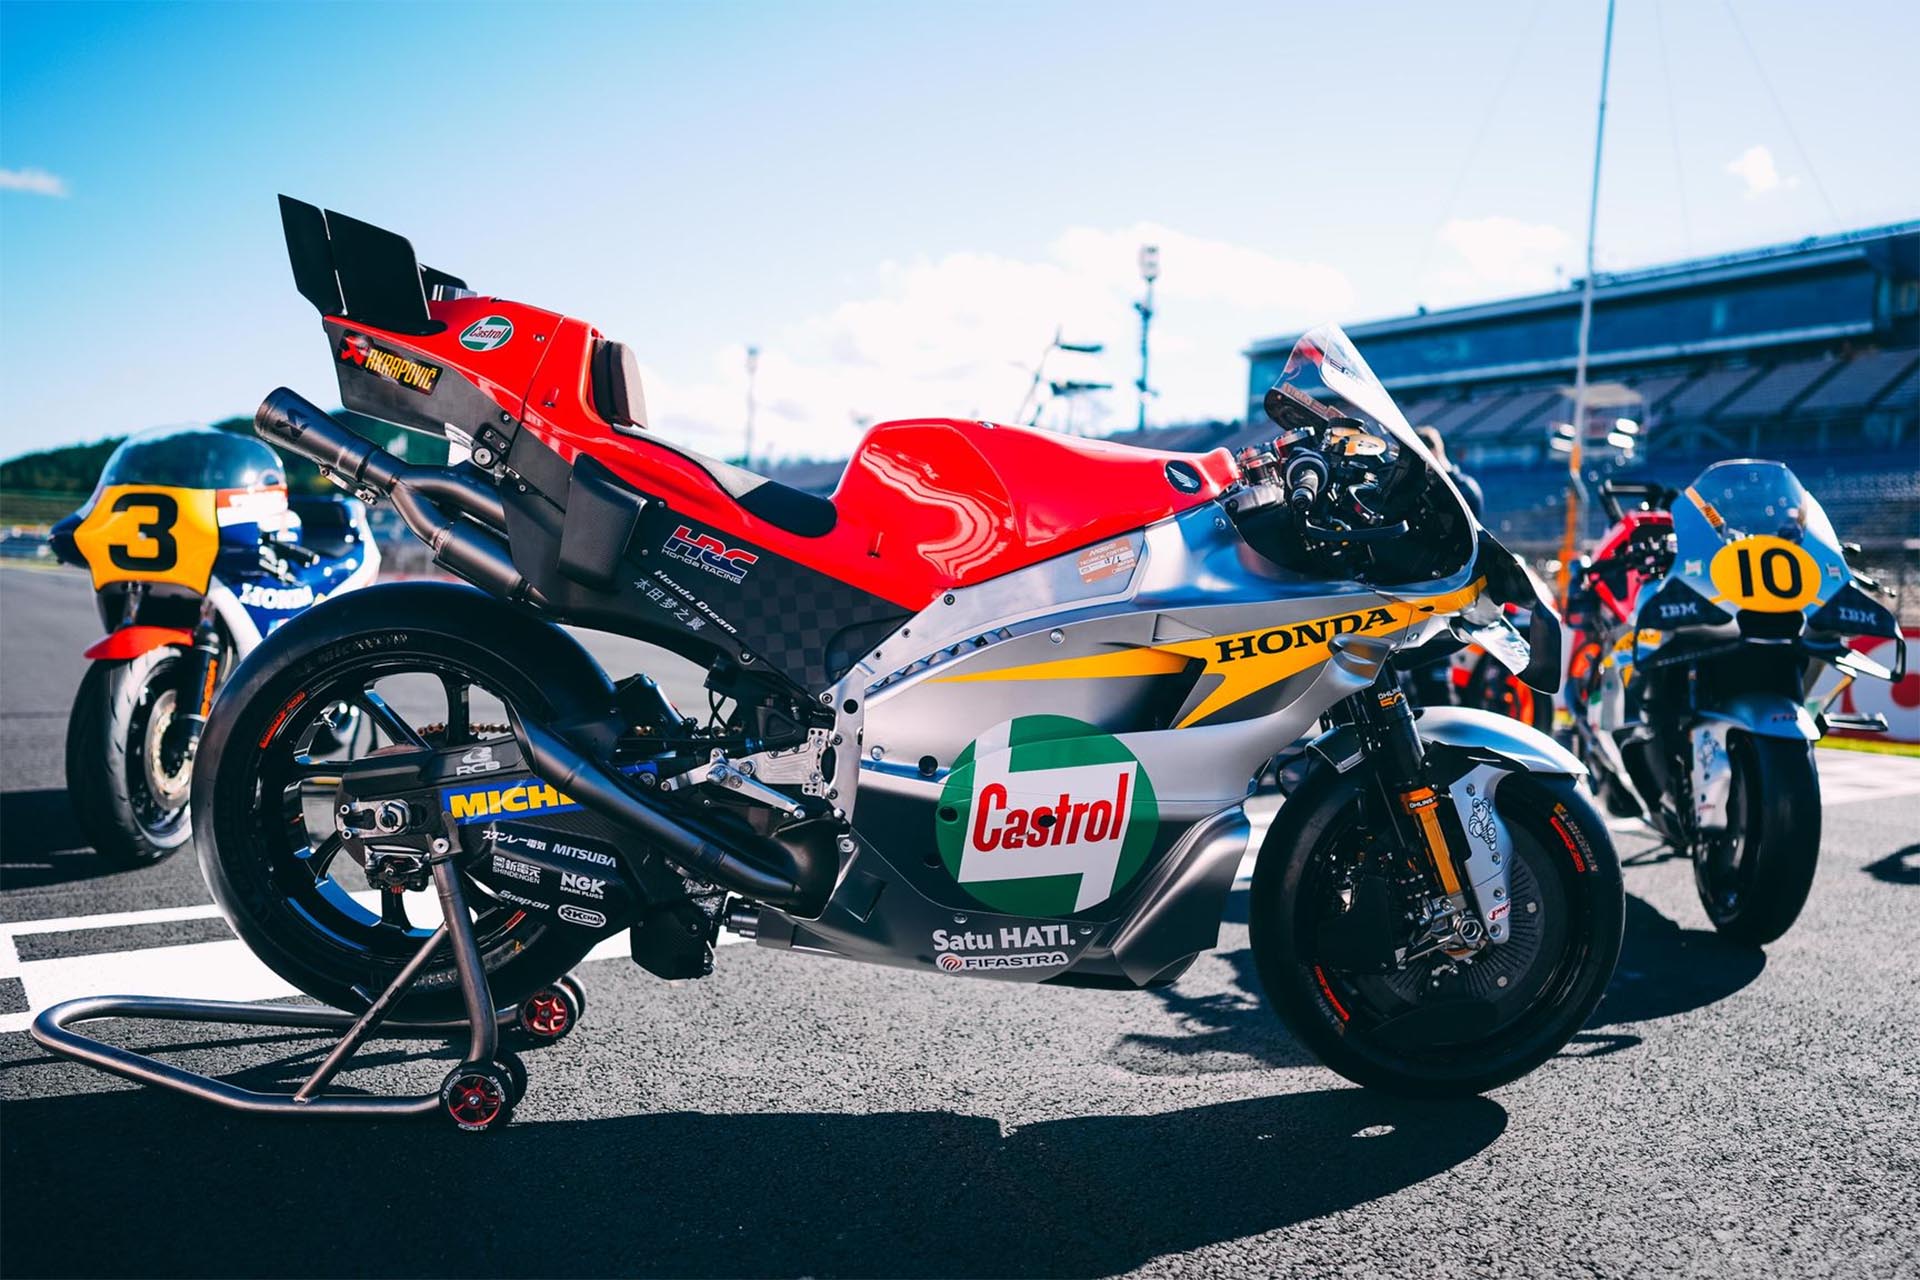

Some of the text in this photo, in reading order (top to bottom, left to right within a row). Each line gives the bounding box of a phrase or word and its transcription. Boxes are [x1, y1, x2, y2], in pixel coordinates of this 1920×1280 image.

[469, 325, 508, 340] Castrol
[365, 349, 438, 391] AKRAPOVIČ
[108, 492, 179, 572] 3
[662, 524, 760, 579] HRC
[661, 548, 742, 584] Honda RACING
[1736, 547, 1803, 600] 10
[653, 569, 738, 635] Honda Dream
[1659, 603, 1698, 618] IBM
[1838, 608, 1878, 627] IBM
[1215, 608, 1397, 663] HONDA
[456, 759, 501, 776] RCB
[449, 783, 577, 819] MICH
[972, 772, 1130, 853] Castrol
[552, 843, 617, 869] MITSUBA
[492, 866, 541, 885] SHINDENGEN
[560, 871, 607, 895] NGK
[499, 889, 551, 911] Snap-on
[560, 908, 584, 920] RK
[931, 924, 1077, 951] Satu HATI.
[964, 953, 1066, 969] FIFASTRA
